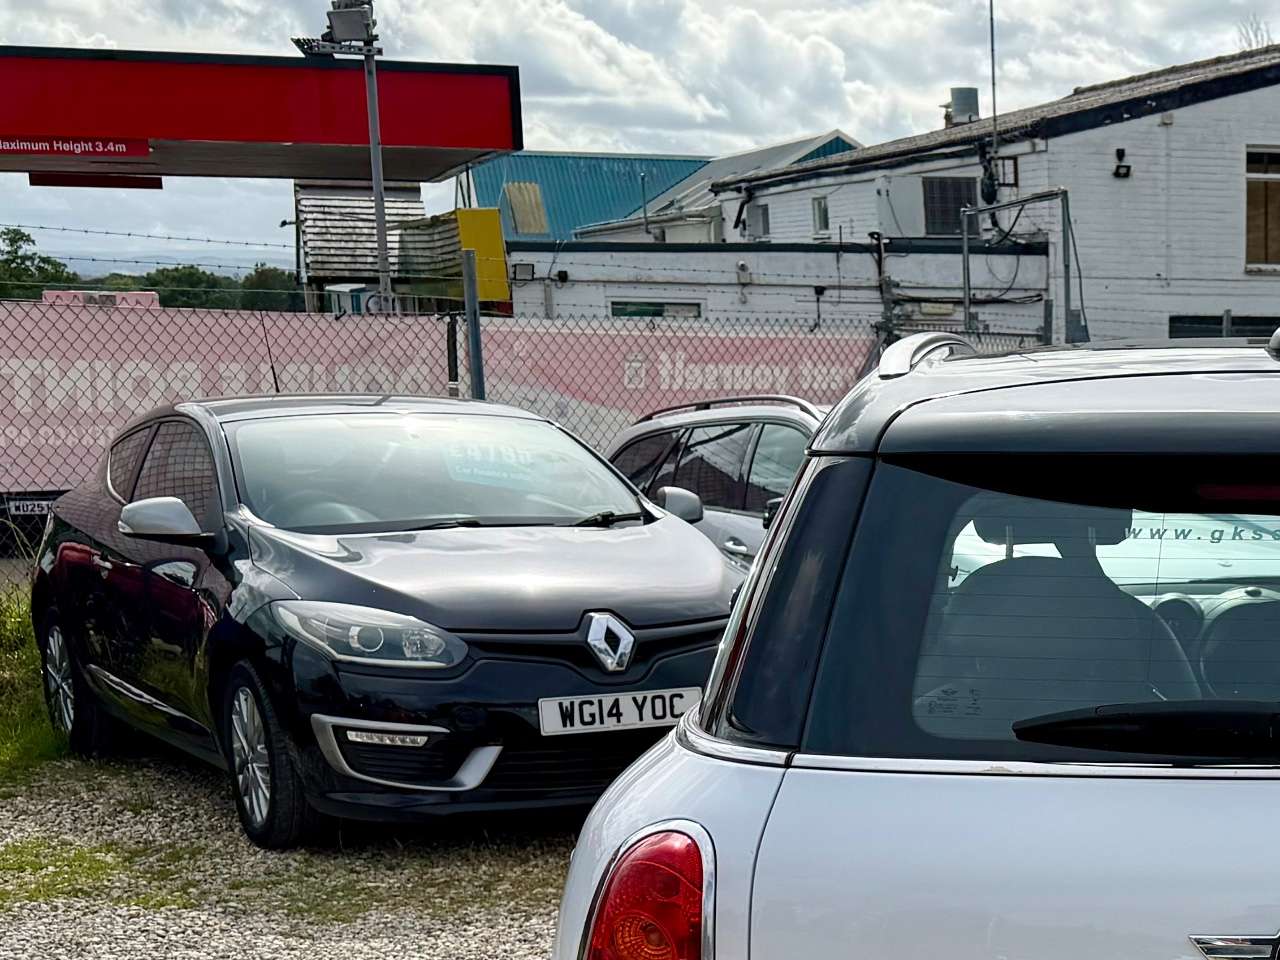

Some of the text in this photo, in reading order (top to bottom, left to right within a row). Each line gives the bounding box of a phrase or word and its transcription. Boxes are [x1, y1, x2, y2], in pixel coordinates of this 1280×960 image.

[53, 140, 93, 153] Height
[95, 142, 127, 152] 3.4m
[558, 693, 685, 728] WG14 YOC
